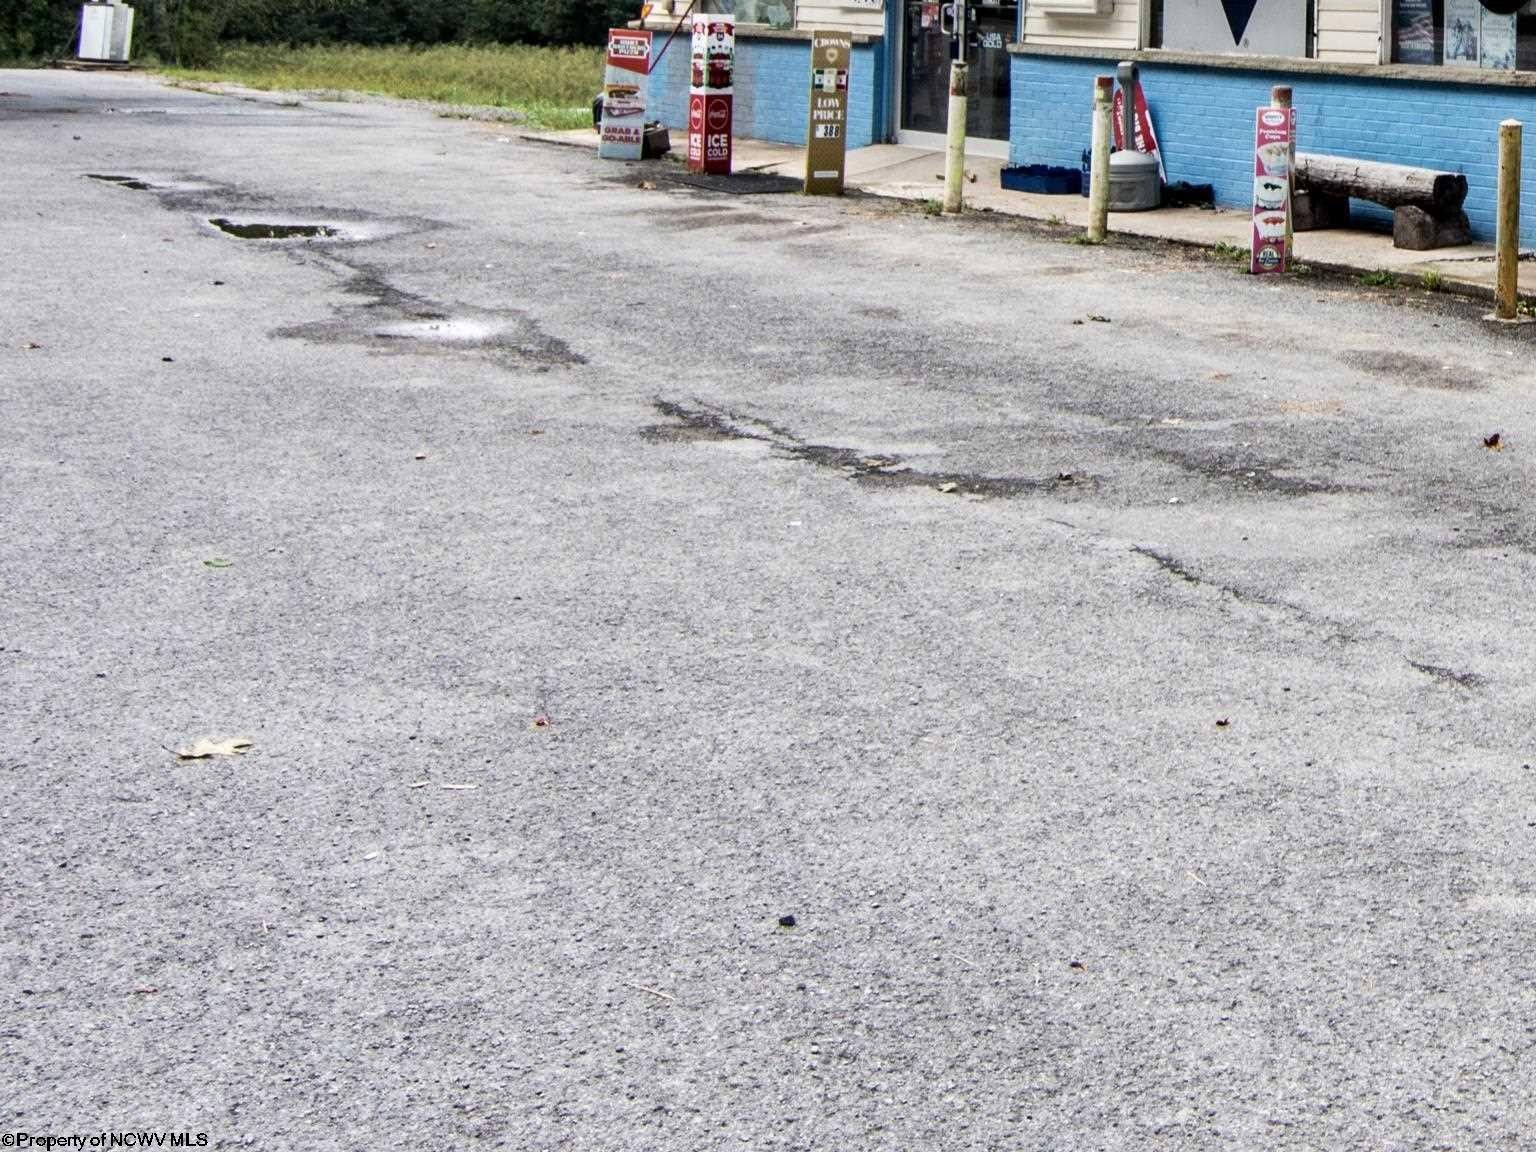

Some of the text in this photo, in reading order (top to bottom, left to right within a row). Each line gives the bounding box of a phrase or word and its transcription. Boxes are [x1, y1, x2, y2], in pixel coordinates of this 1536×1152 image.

[814, 37, 851, 49] CROWNS
[983, 39, 1002, 48] GOLD
[817, 98, 840, 108] LOW
[813, 109, 844, 121] PRICE
[604, 126, 629, 135] GRAB
[708, 134, 728, 147] ICE
[707, 147, 728, 157] COLD
